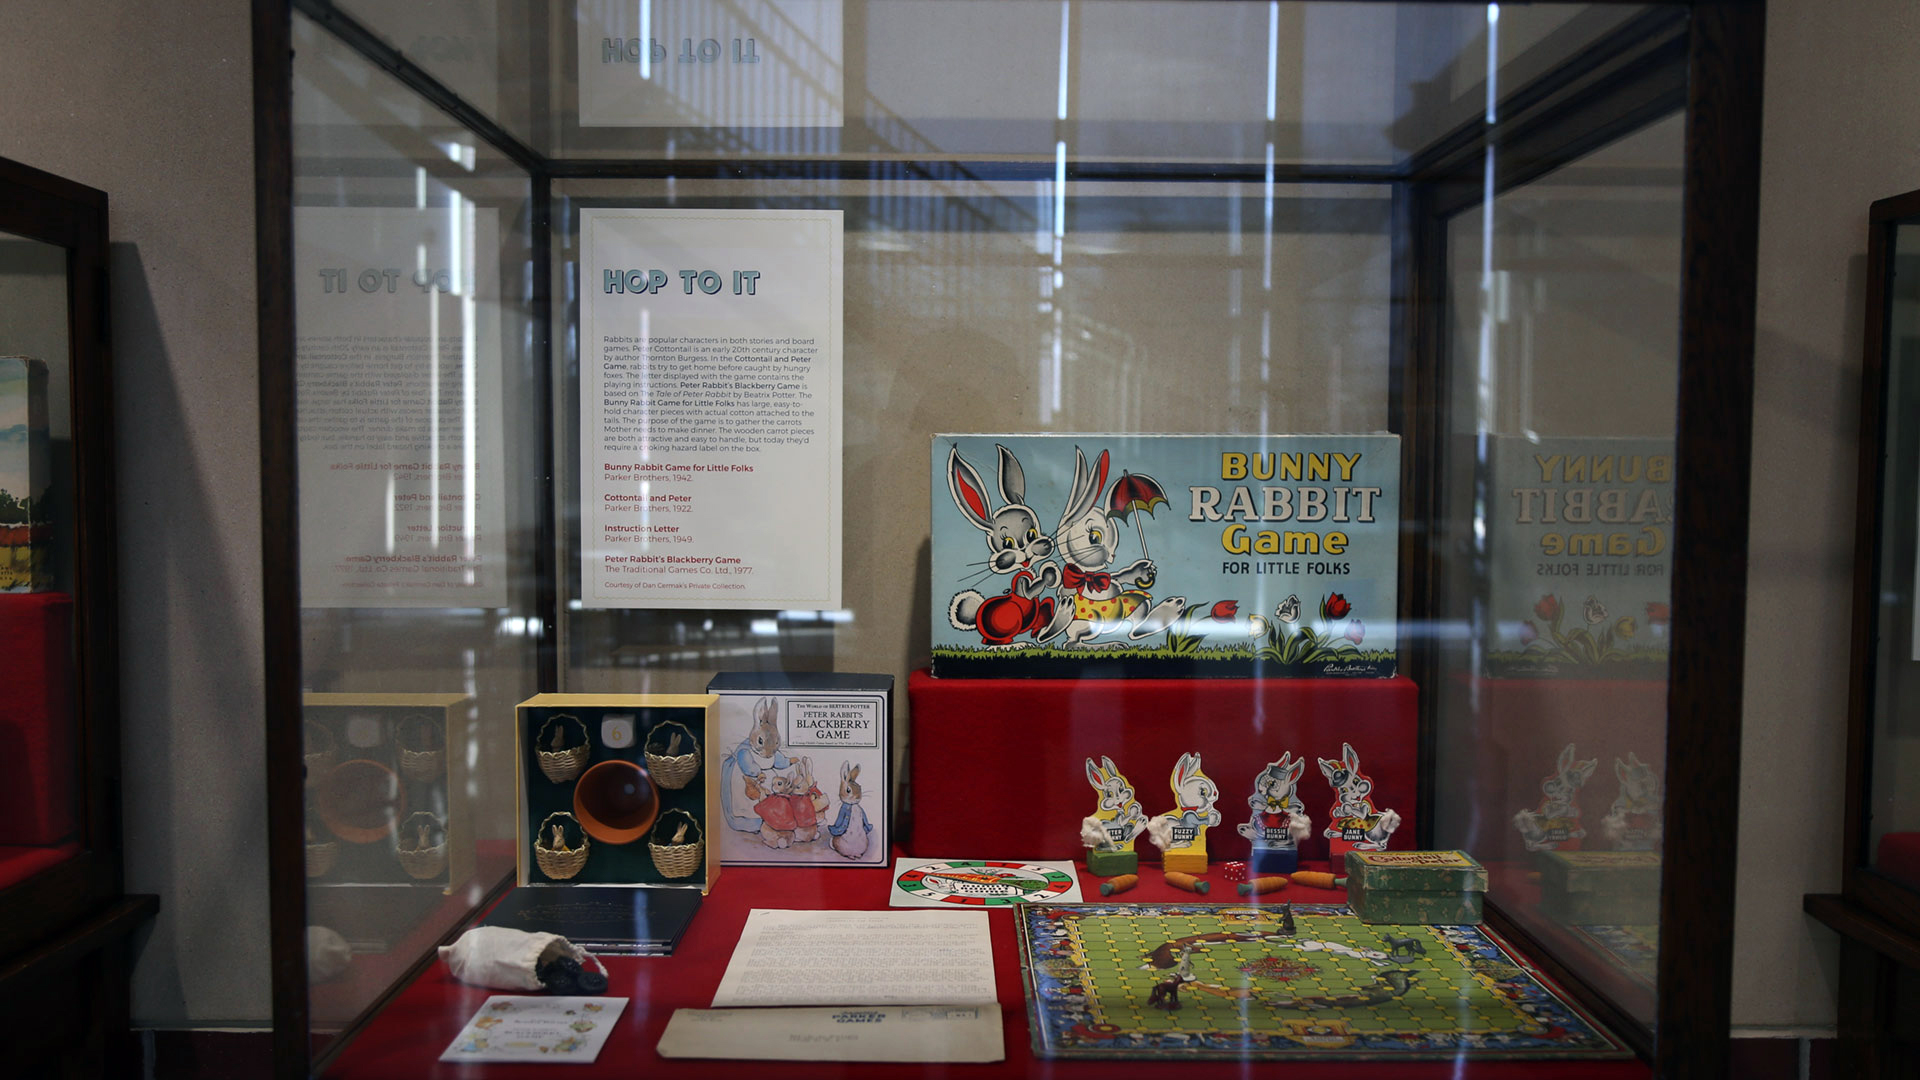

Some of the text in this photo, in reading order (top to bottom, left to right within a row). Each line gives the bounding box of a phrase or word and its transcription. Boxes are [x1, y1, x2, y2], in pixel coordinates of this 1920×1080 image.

[603, 268, 761, 296] HOP TO IT
[648, 337, 678, 345] popular
[712, 346, 731, 354] early
[604, 354, 613, 362] by
[678, 355, 710, 363] Burgess.
[744, 365, 771, 373] caught
[773, 365, 782, 373] by
[783, 365, 811, 373] hungry
[733, 391, 742, 399] by
[604, 464, 633, 472] Bunny
[693, 464, 705, 472] for
[707, 464, 729, 472] Little
[1221, 451, 1362, 482] BUNNY
[604, 504, 632, 512] Parker
[1188, 485, 1382, 524] RABBIT
[1221, 523, 1349, 556] Game
[630, 555, 665, 563] Rabbit's
[667, 556, 714, 565] Blackberry
[1222, 561, 1351, 575] FOR LITTLE FOLKS
[796, 719, 870, 729] BLACKBERRY
[611, 726, 622, 741] 6
[816, 730, 850, 739] GAME
